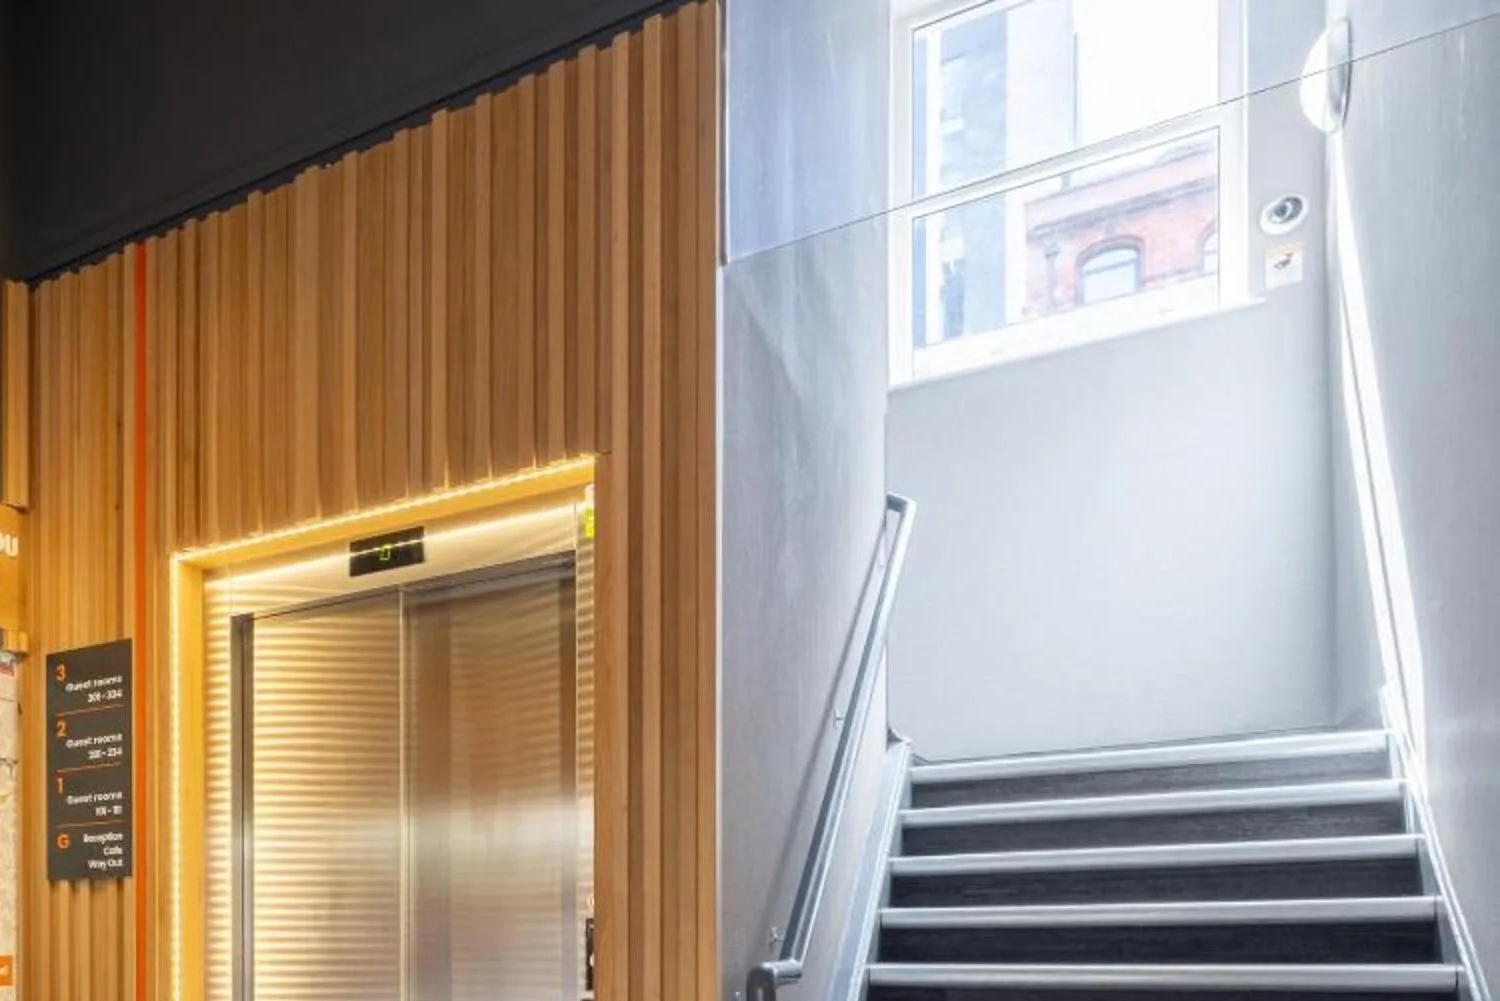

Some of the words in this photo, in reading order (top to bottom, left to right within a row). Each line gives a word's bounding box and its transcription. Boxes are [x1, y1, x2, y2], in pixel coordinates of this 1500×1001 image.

[56, 664, 66, 681] 3
[93, 675, 123, 687] rooms
[56, 721, 67, 737] 2
[93, 733, 123, 745] rooms
[57, 777, 63, 794] 1
[93, 791, 123, 803] rooms
[57, 833, 70, 849] G
[87, 859, 107, 871] Way
